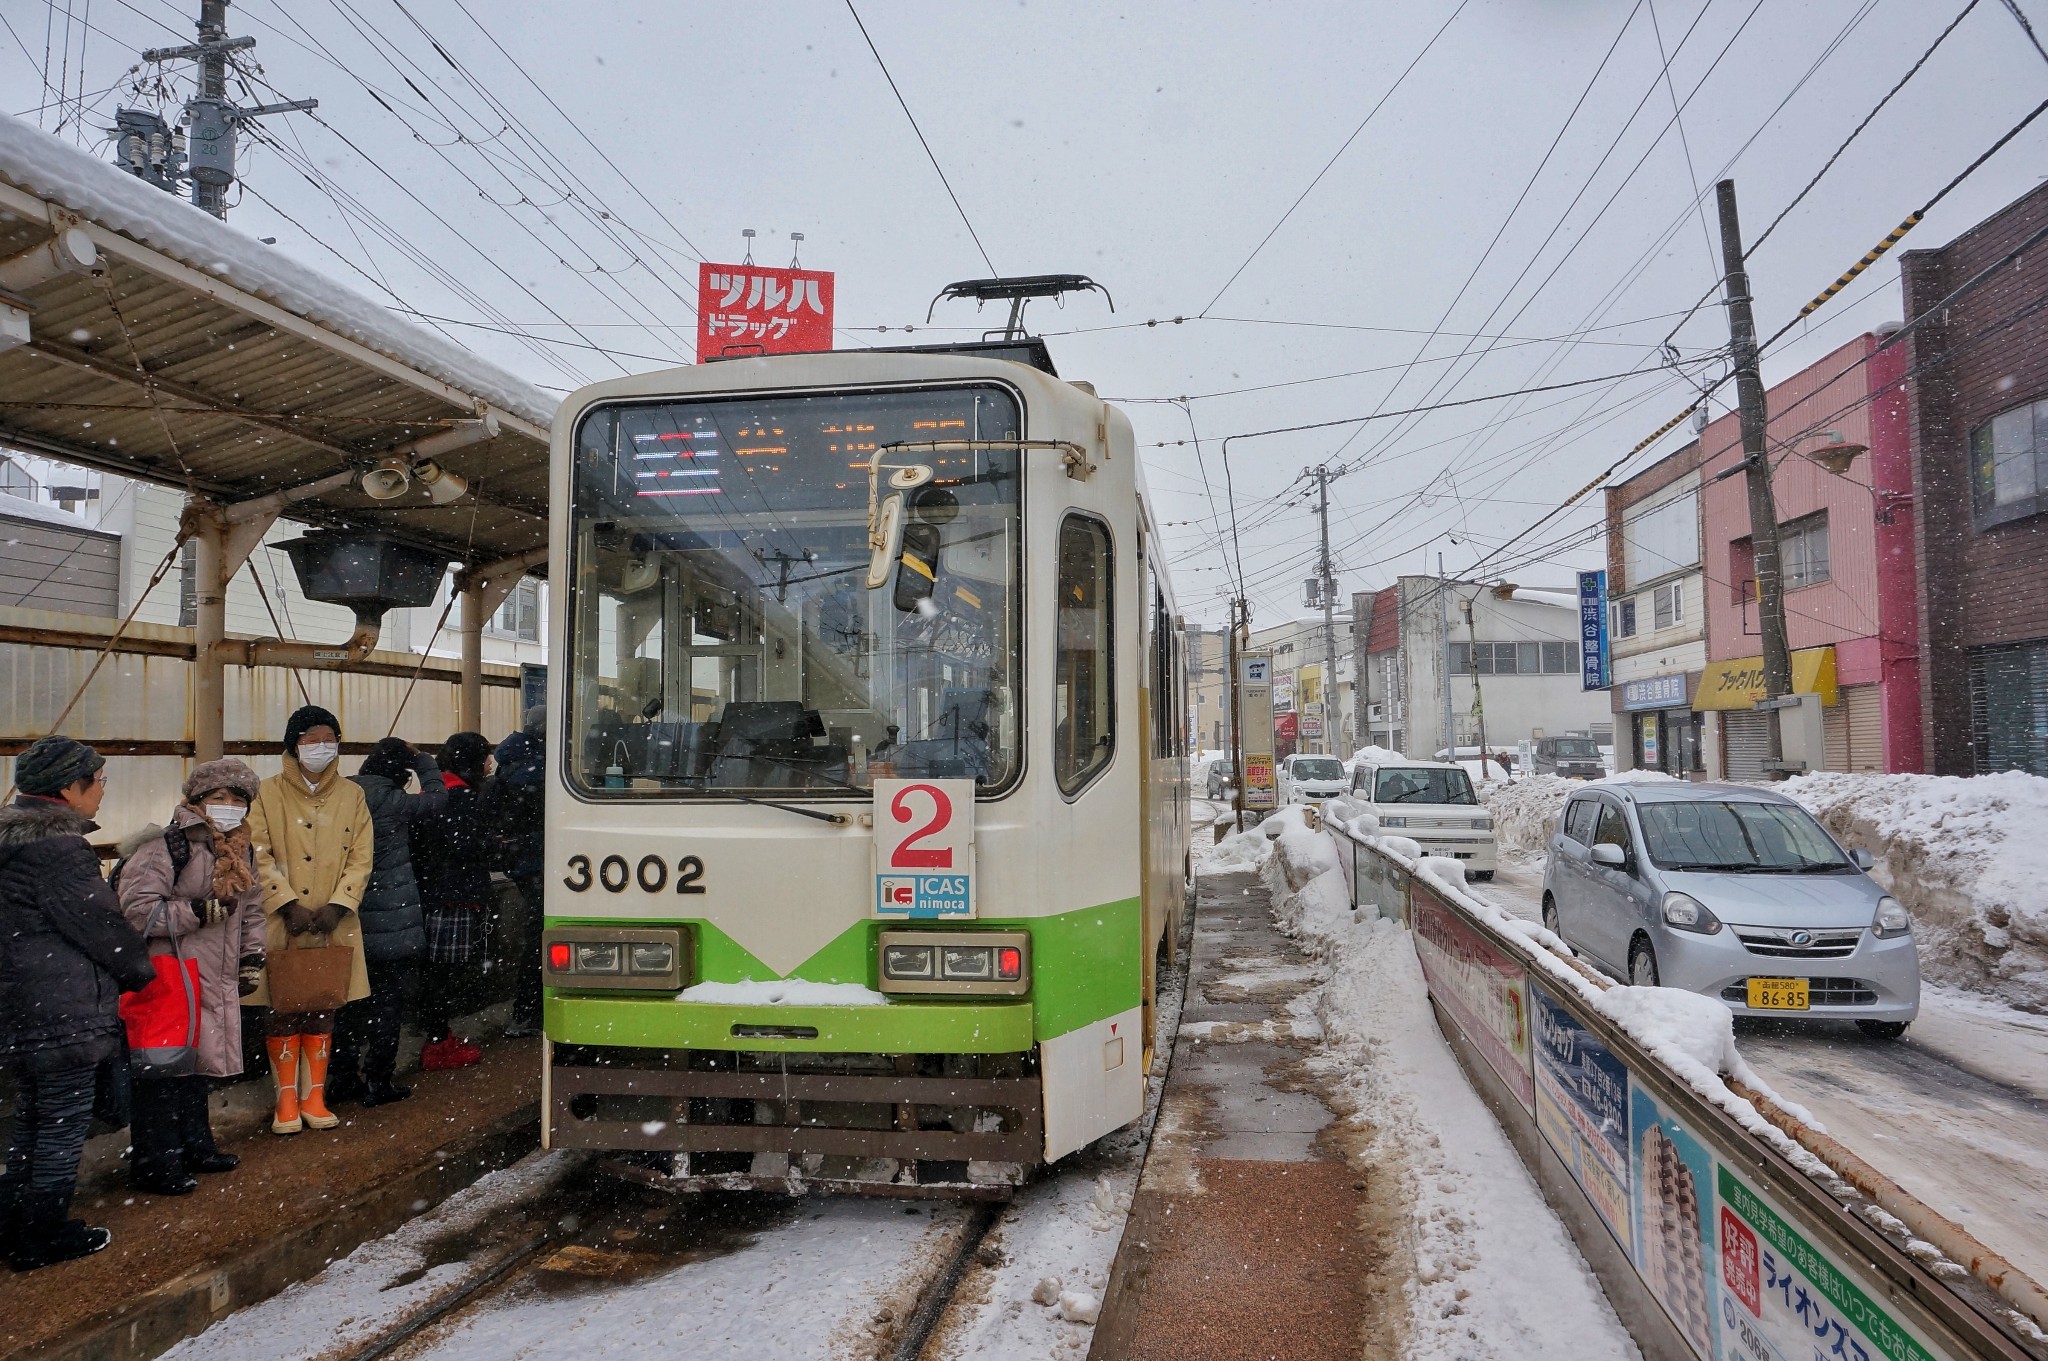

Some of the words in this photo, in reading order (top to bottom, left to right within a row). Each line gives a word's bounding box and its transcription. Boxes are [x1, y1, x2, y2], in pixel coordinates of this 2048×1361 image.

[709, 272, 825, 315] ツルハ
[708, 313, 798, 341] ドラッグ
[1583, 606, 1600, 687] 渋谷整骨院
[1638, 678, 1680, 702] 渋谷整骨院
[1718, 668, 1767, 692] ブックハウ
[891, 784, 953, 868] 2
[563, 853, 708, 895] 3002
[919, 877, 966, 896] ICAS
[919, 896, 966, 910] nimoca
[1761, 990, 1806, 1007] 86-85
[1723, 1216, 1756, 1276] 好評
[1725, 1256, 1758, 1306] 発売中
[1732, 1184, 1929, 1361] 室内見学希望のお客様はいつでもお気
